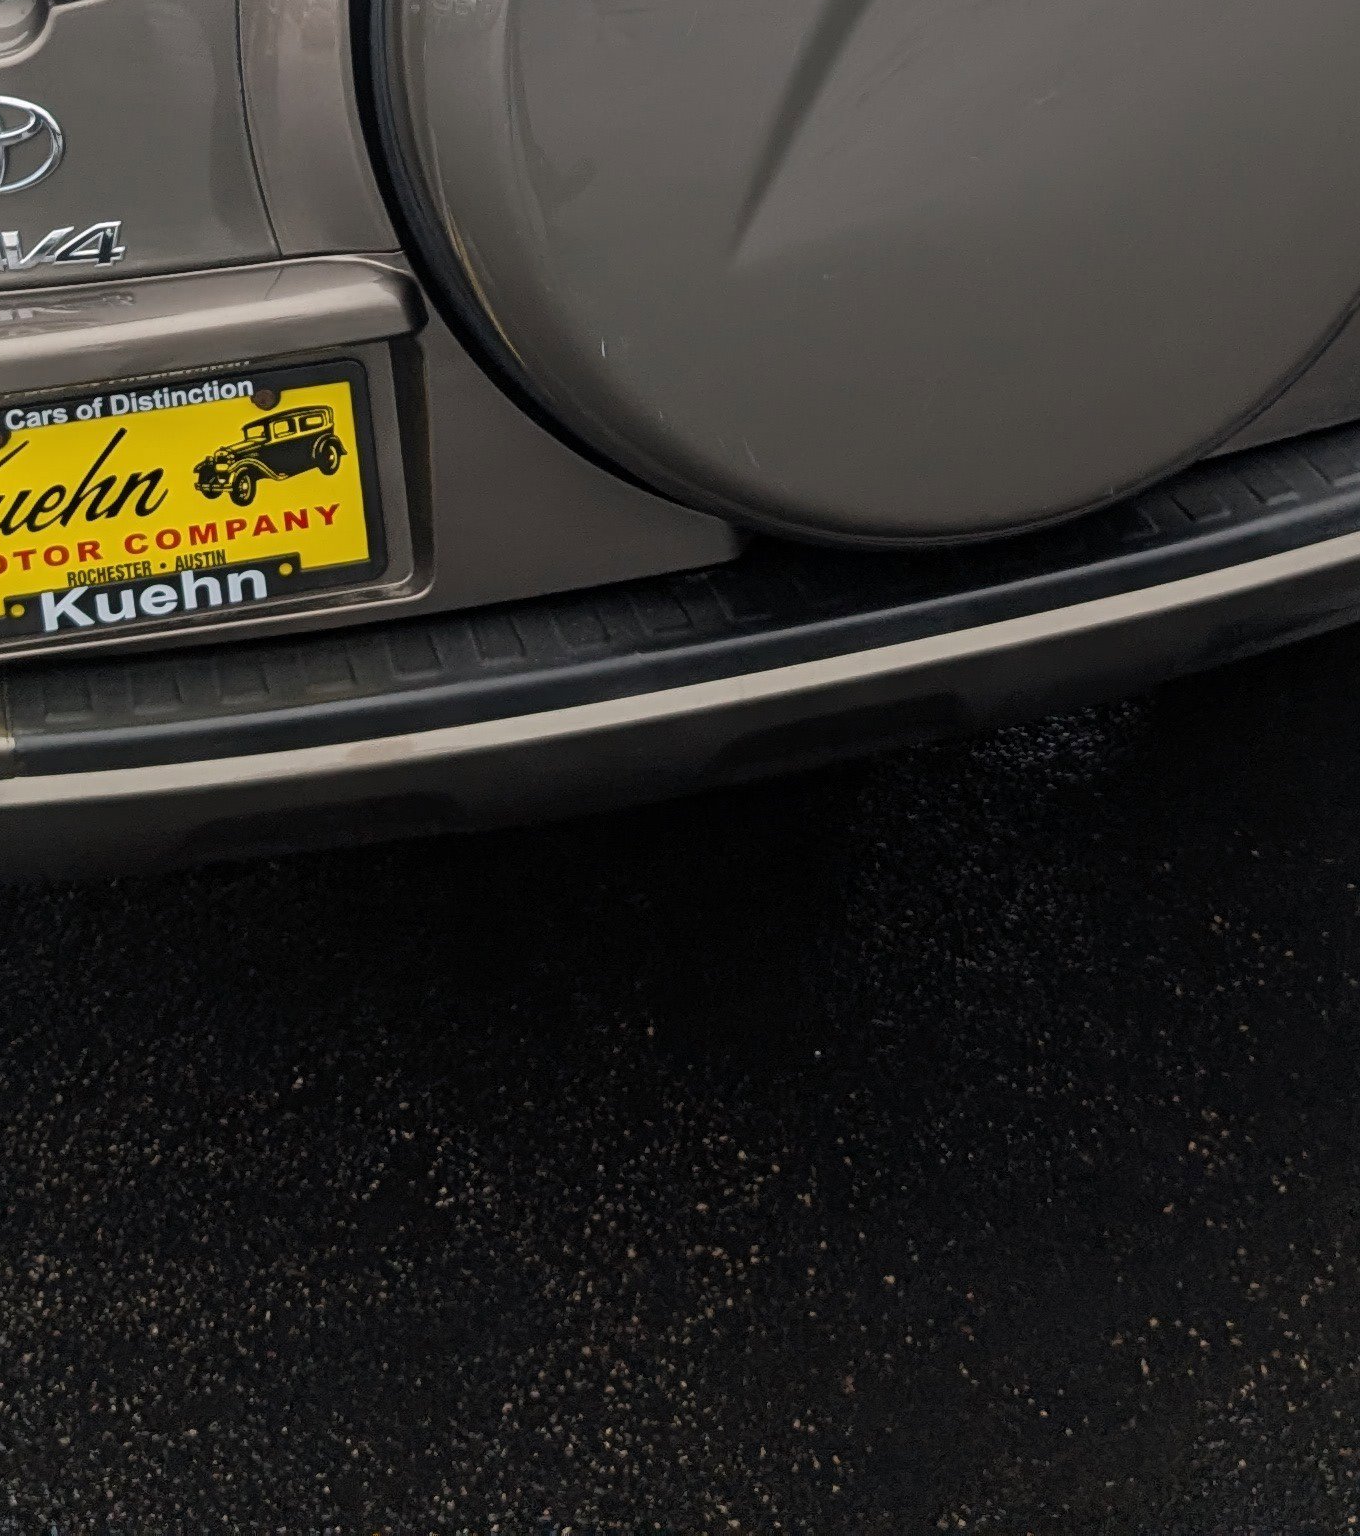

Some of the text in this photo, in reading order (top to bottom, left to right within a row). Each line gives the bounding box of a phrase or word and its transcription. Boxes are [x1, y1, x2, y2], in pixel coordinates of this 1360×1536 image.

[4, 379, 254, 431] Cars of Distinction
[124, 503, 340, 555] COMPANY
[67, 548, 228, 588] ROCHESTER AUSTIN
[40, 569, 268, 633] Kuehn
